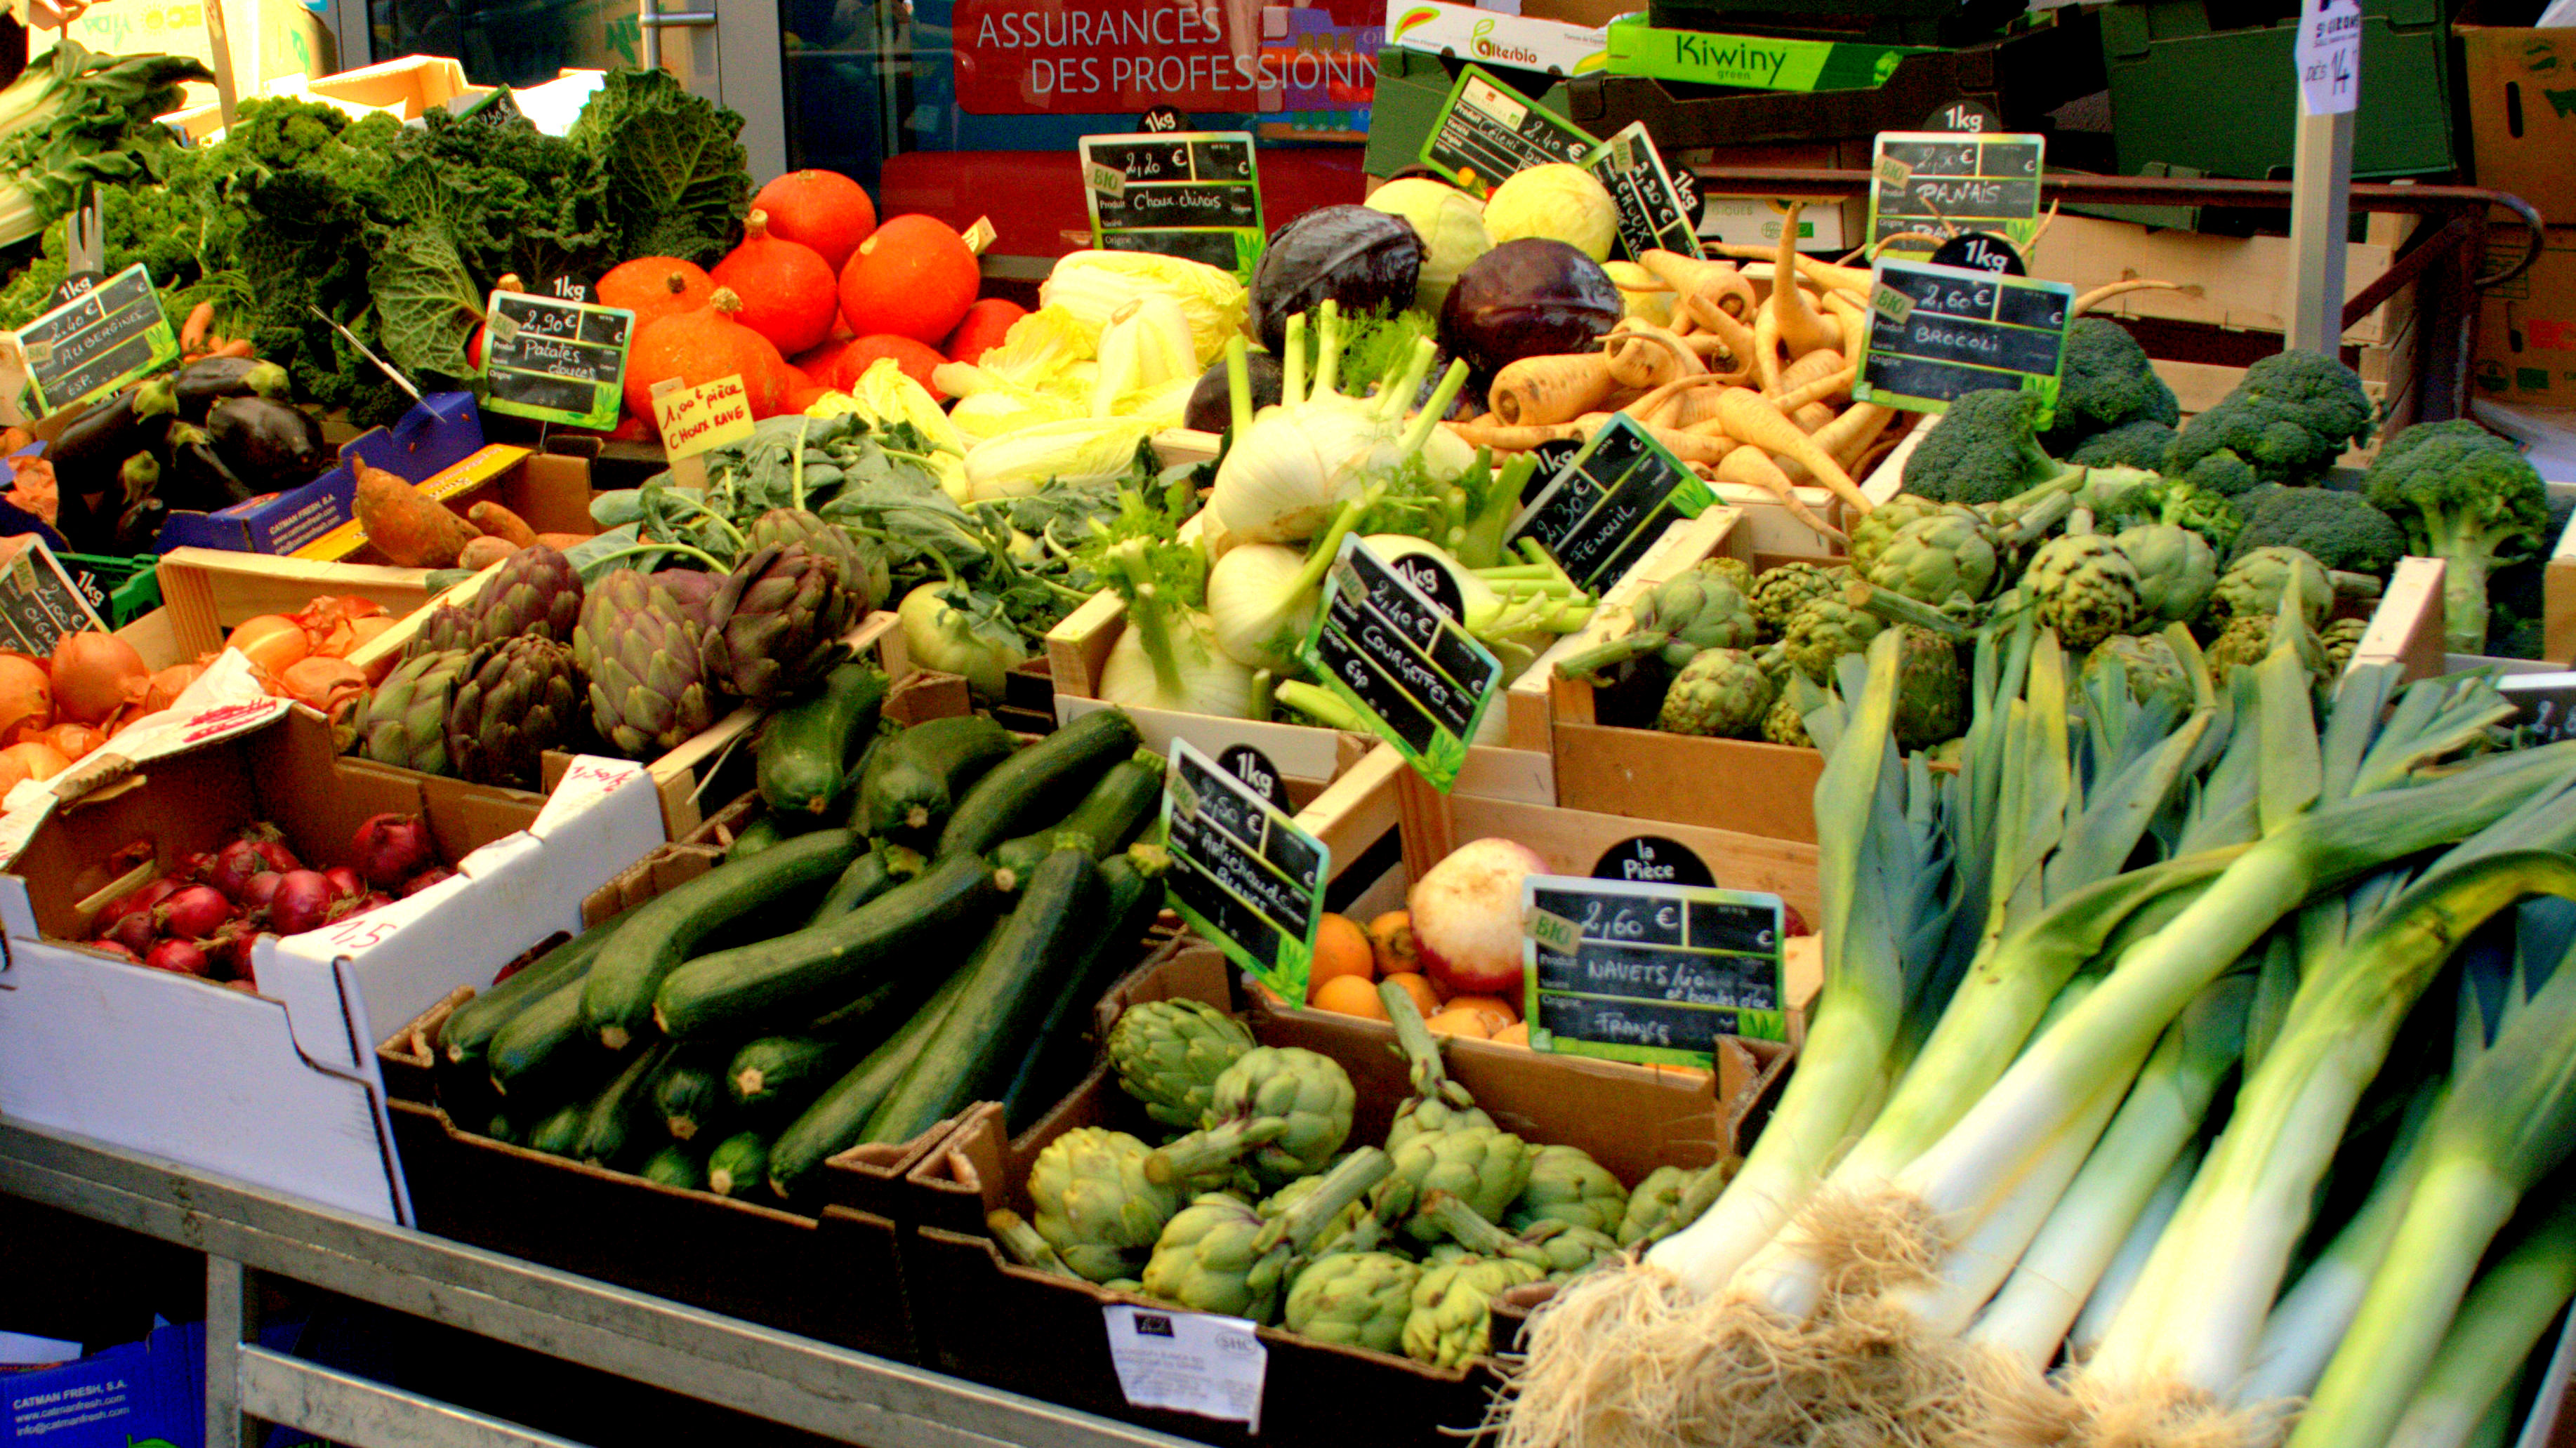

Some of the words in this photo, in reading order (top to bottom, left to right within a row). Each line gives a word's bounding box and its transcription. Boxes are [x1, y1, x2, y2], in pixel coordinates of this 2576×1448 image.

[977, 7, 1222, 48] ASSURANCES
[1477, 40, 1537, 63] alterbio
[1677, 35, 1787, 85] Kiwiny
[1033, 58, 1100, 93] DES
[1717, 70, 1751, 80] green
[1145, 112, 1176, 133] 1kg
[1455, 102, 1482, 124] Produit
[1946, 105, 1983, 133] 1kg
[1126, 152, 1160, 177] 2,20
[1173, 150, 1187, 166] €
[1239, 161, 1249, 175] €
[1567, 142, 1587, 163] €
[1960, 149, 1974, 164] €
[2023, 160, 2035, 172] €
[1094, 168, 1118, 192] BIO
[1673, 171, 1698, 212] 1kg
[1099, 199, 1125, 209] Produit
[1660, 208, 1674, 224] €
[1966, 239, 2008, 274] 1kg
[59, 277, 93, 300] 1kg
[84, 303, 98, 316] €
[137, 282, 147, 293] €
[554, 275, 586, 302] 1kg
[1877, 289, 1905, 314] BIO
[1921, 284, 1971, 310] 2,60
[1974, 289, 1991, 307] €
[2049, 312, 2063, 325] €
[522, 310, 564, 336] 2,90
[564, 314, 577, 328] €
[614, 332, 623, 343] €
[670, 419, 710, 450] CHOUX
[1536, 448, 1575, 475] 1kg
[1573, 479, 1590, 496] €
[1629, 437, 1642, 452] €
[77, 570, 105, 608] 1kg
[72, 614, 86, 630] €
[1416, 617, 1434, 637] €
[1471, 679, 1484, 696] €
[1236, 752, 1274, 799] 1kg
[1246, 813, 1262, 835] €
[1304, 870, 1317, 888] €
[1636, 839, 1655, 860] la
[1623, 858, 1675, 881] Pièce
[1535, 915, 1571, 945] BIO
[1580, 901, 1644, 939] 2,60
[1656, 906, 1679, 929] €
[1757, 929, 1775, 946] €
[1587, 959, 1667, 985] NAVETS
[13, 1391, 62, 1411] CATMAN
[14, 1394, 127, 1423] www.catmanfresh.com
